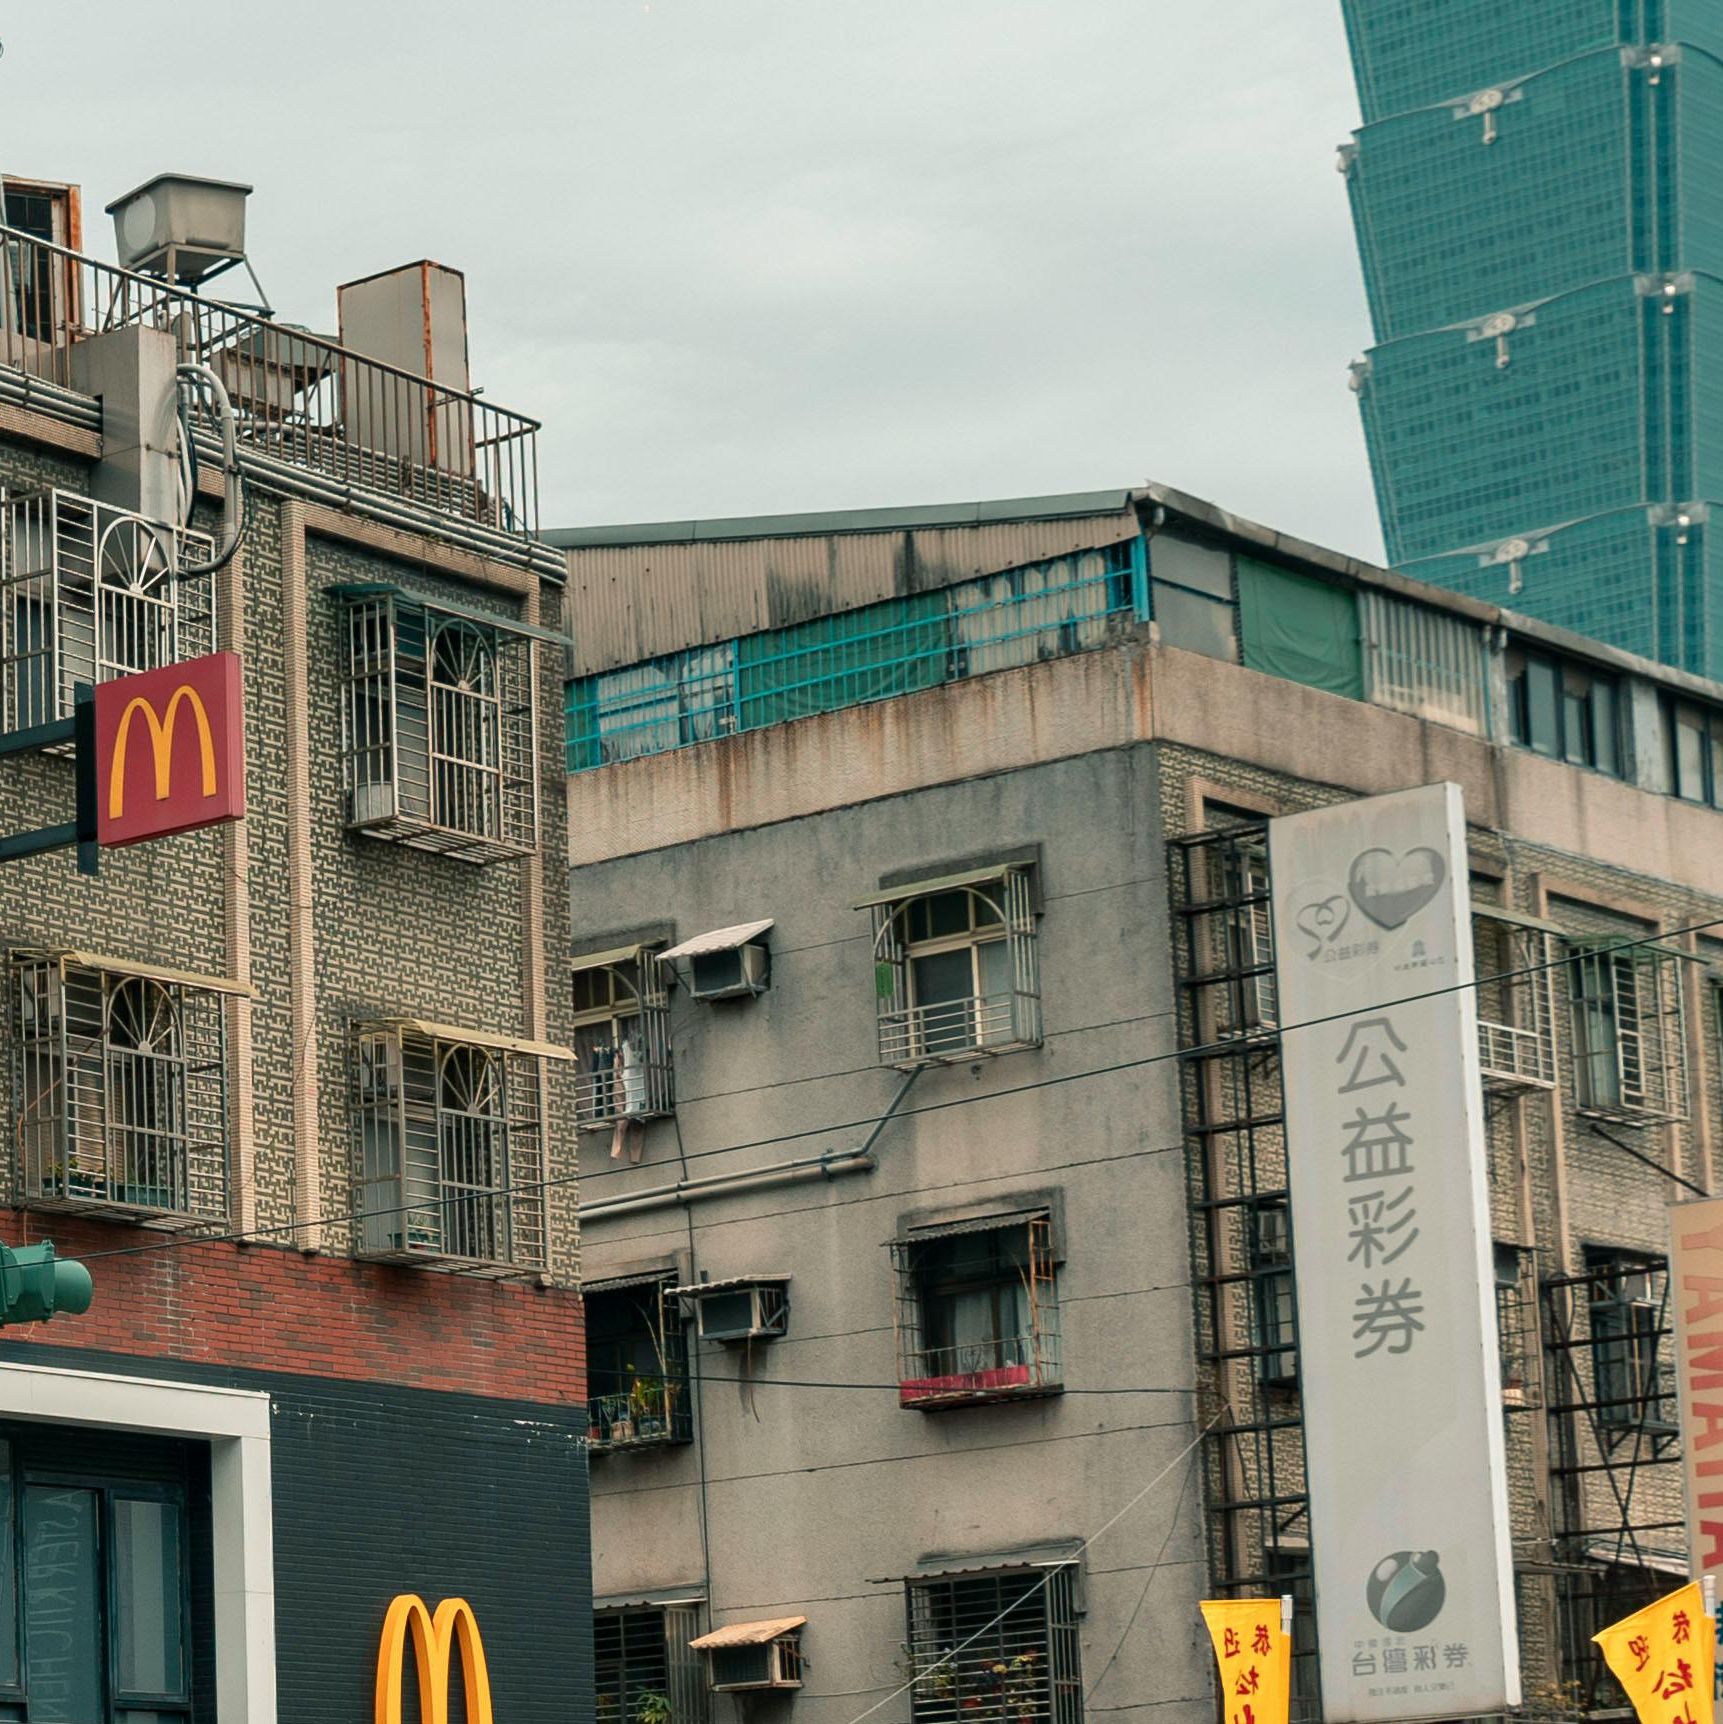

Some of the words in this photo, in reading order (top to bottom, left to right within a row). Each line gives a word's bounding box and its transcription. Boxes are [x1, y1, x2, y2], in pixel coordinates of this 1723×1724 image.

[1335, 1016, 1426, 1360] 公益彩券
[1352, 1643, 1469, 1676] 台灣彩券
